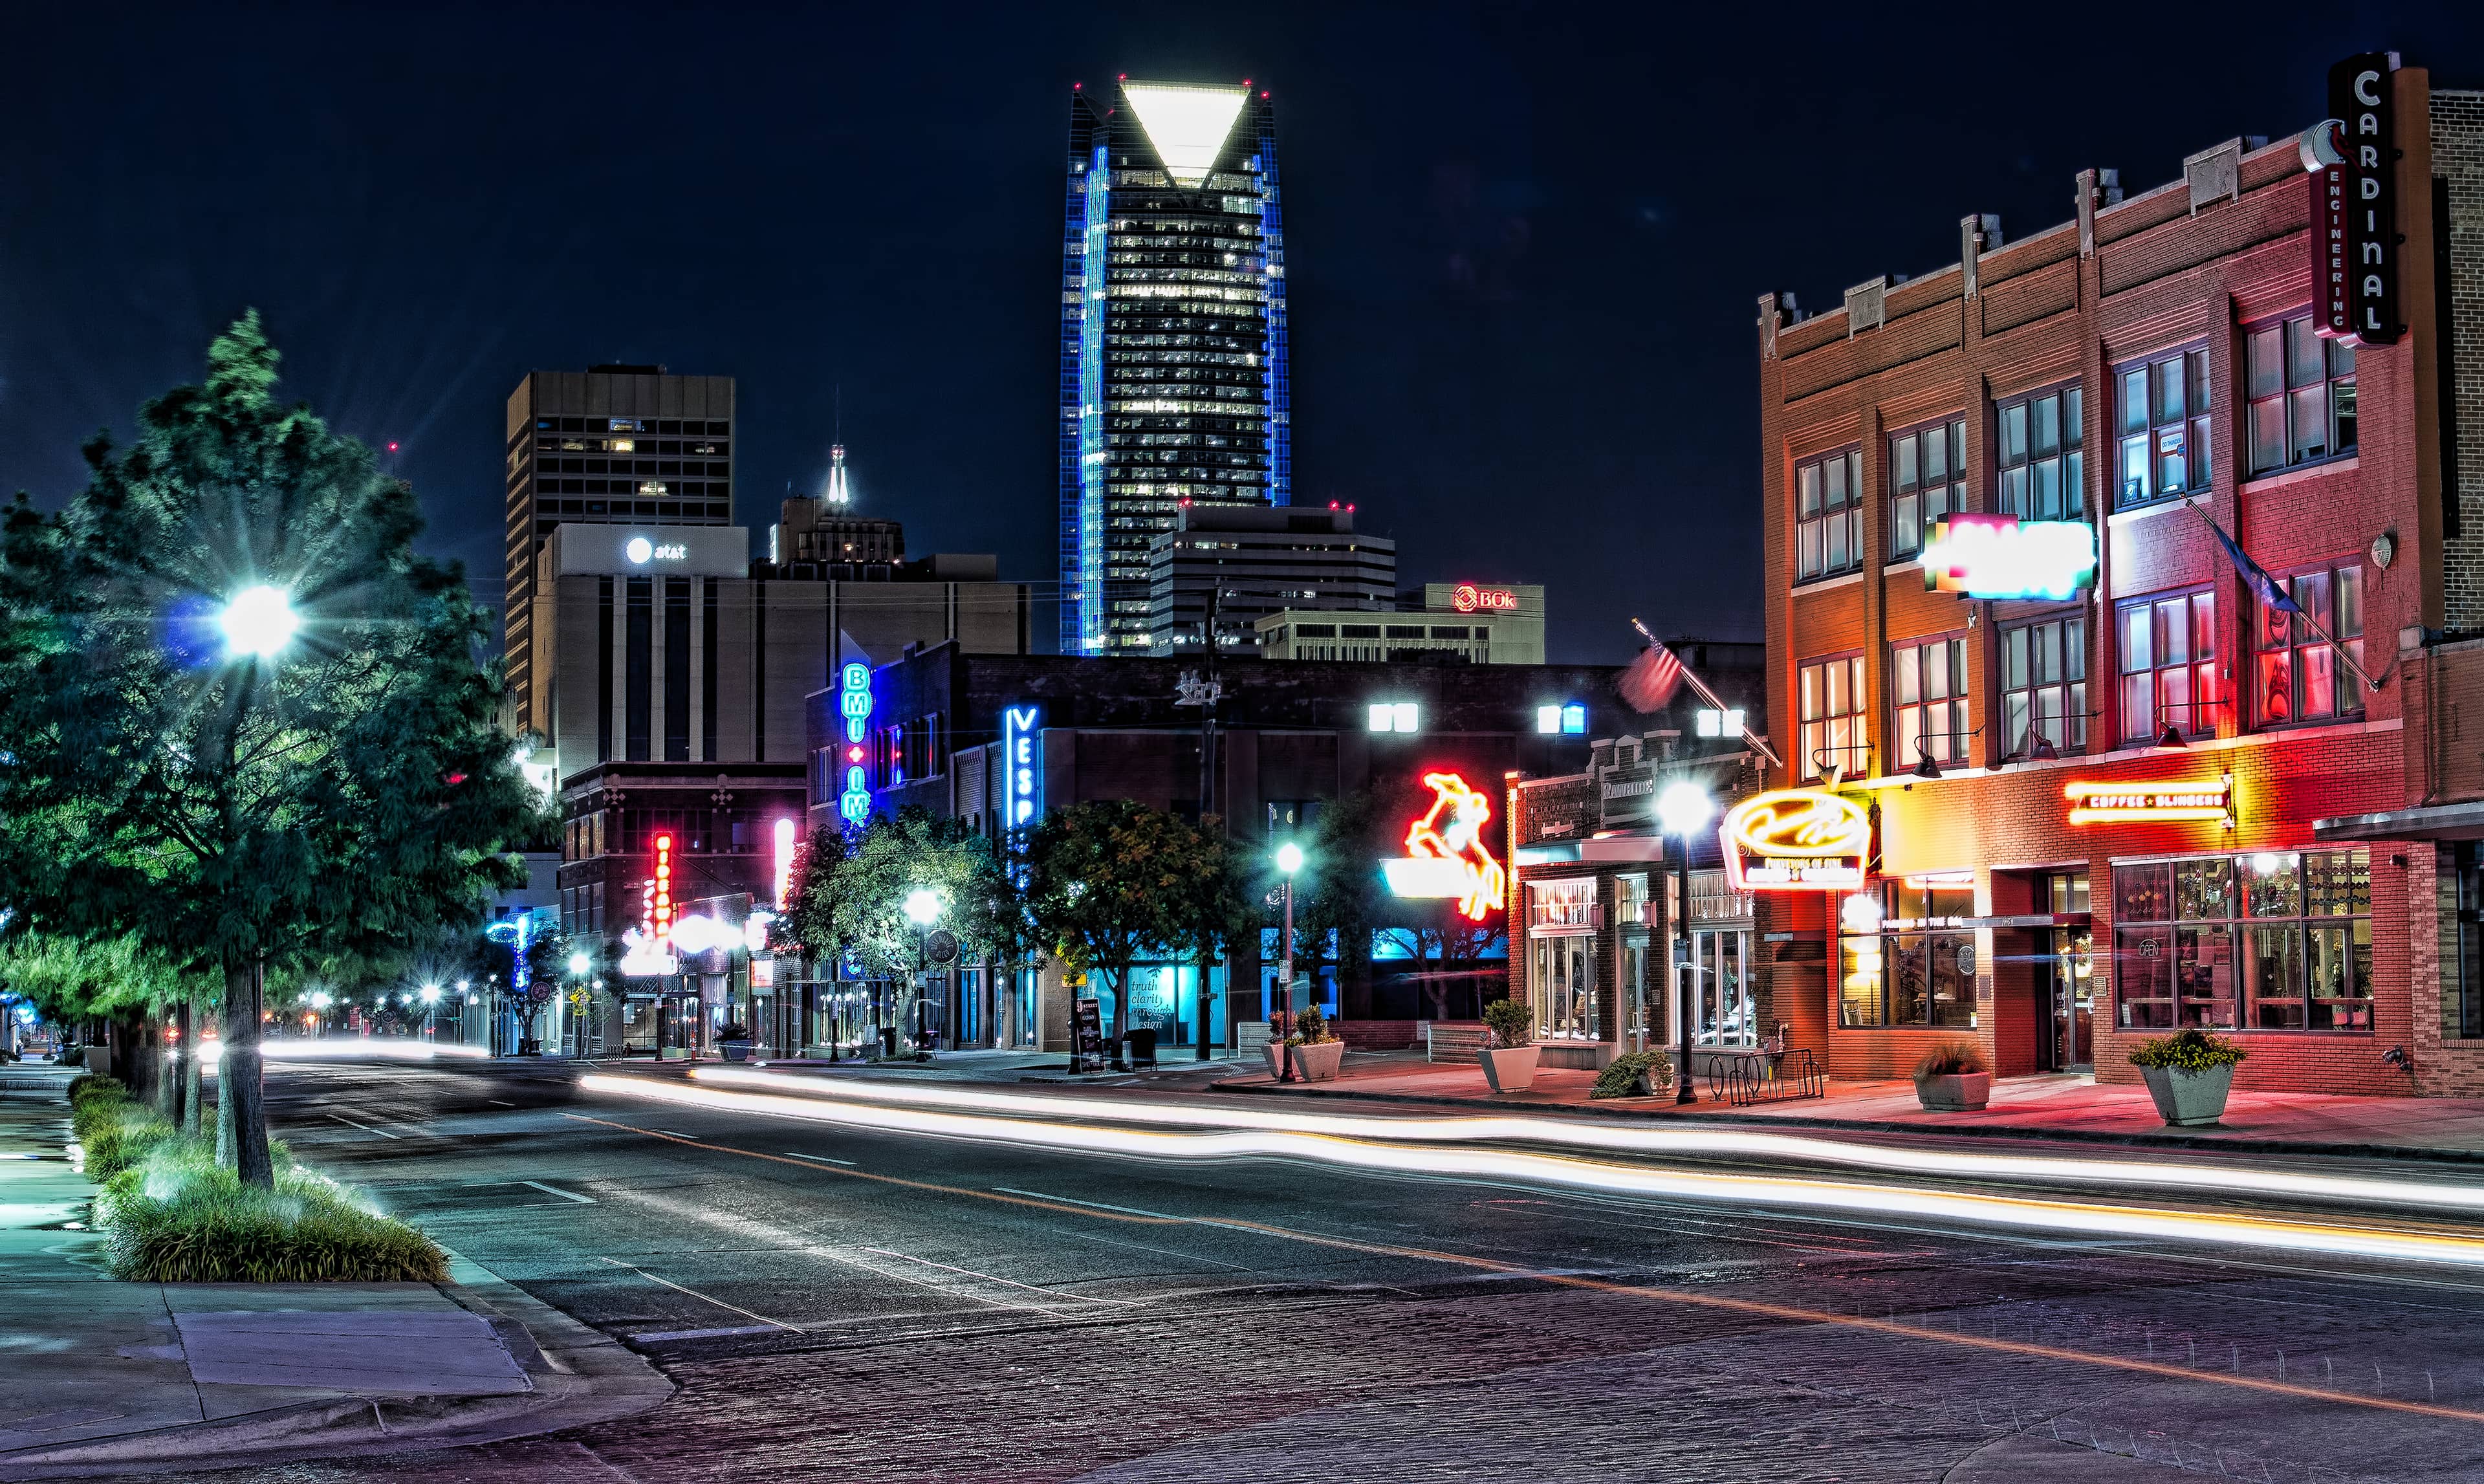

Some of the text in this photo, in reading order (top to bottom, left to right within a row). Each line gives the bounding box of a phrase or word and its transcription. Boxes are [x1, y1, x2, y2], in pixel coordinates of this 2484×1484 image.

[2329, 171, 2344, 327] ENGINEERING
[843, 664, 870, 742] BMI
[1012, 708, 1038, 827] VESP
[1603, 780, 1653, 800] RAWHIDE
[2090, 795, 2145, 807] COFFEE
[2140, 944, 2159, 956] OPEN
[1131, 979, 1157, 991] truth
[1131, 991, 1163, 1008] clarity
[1131, 1004, 1171, 1021] through
[1131, 1018, 1163, 1031] design
